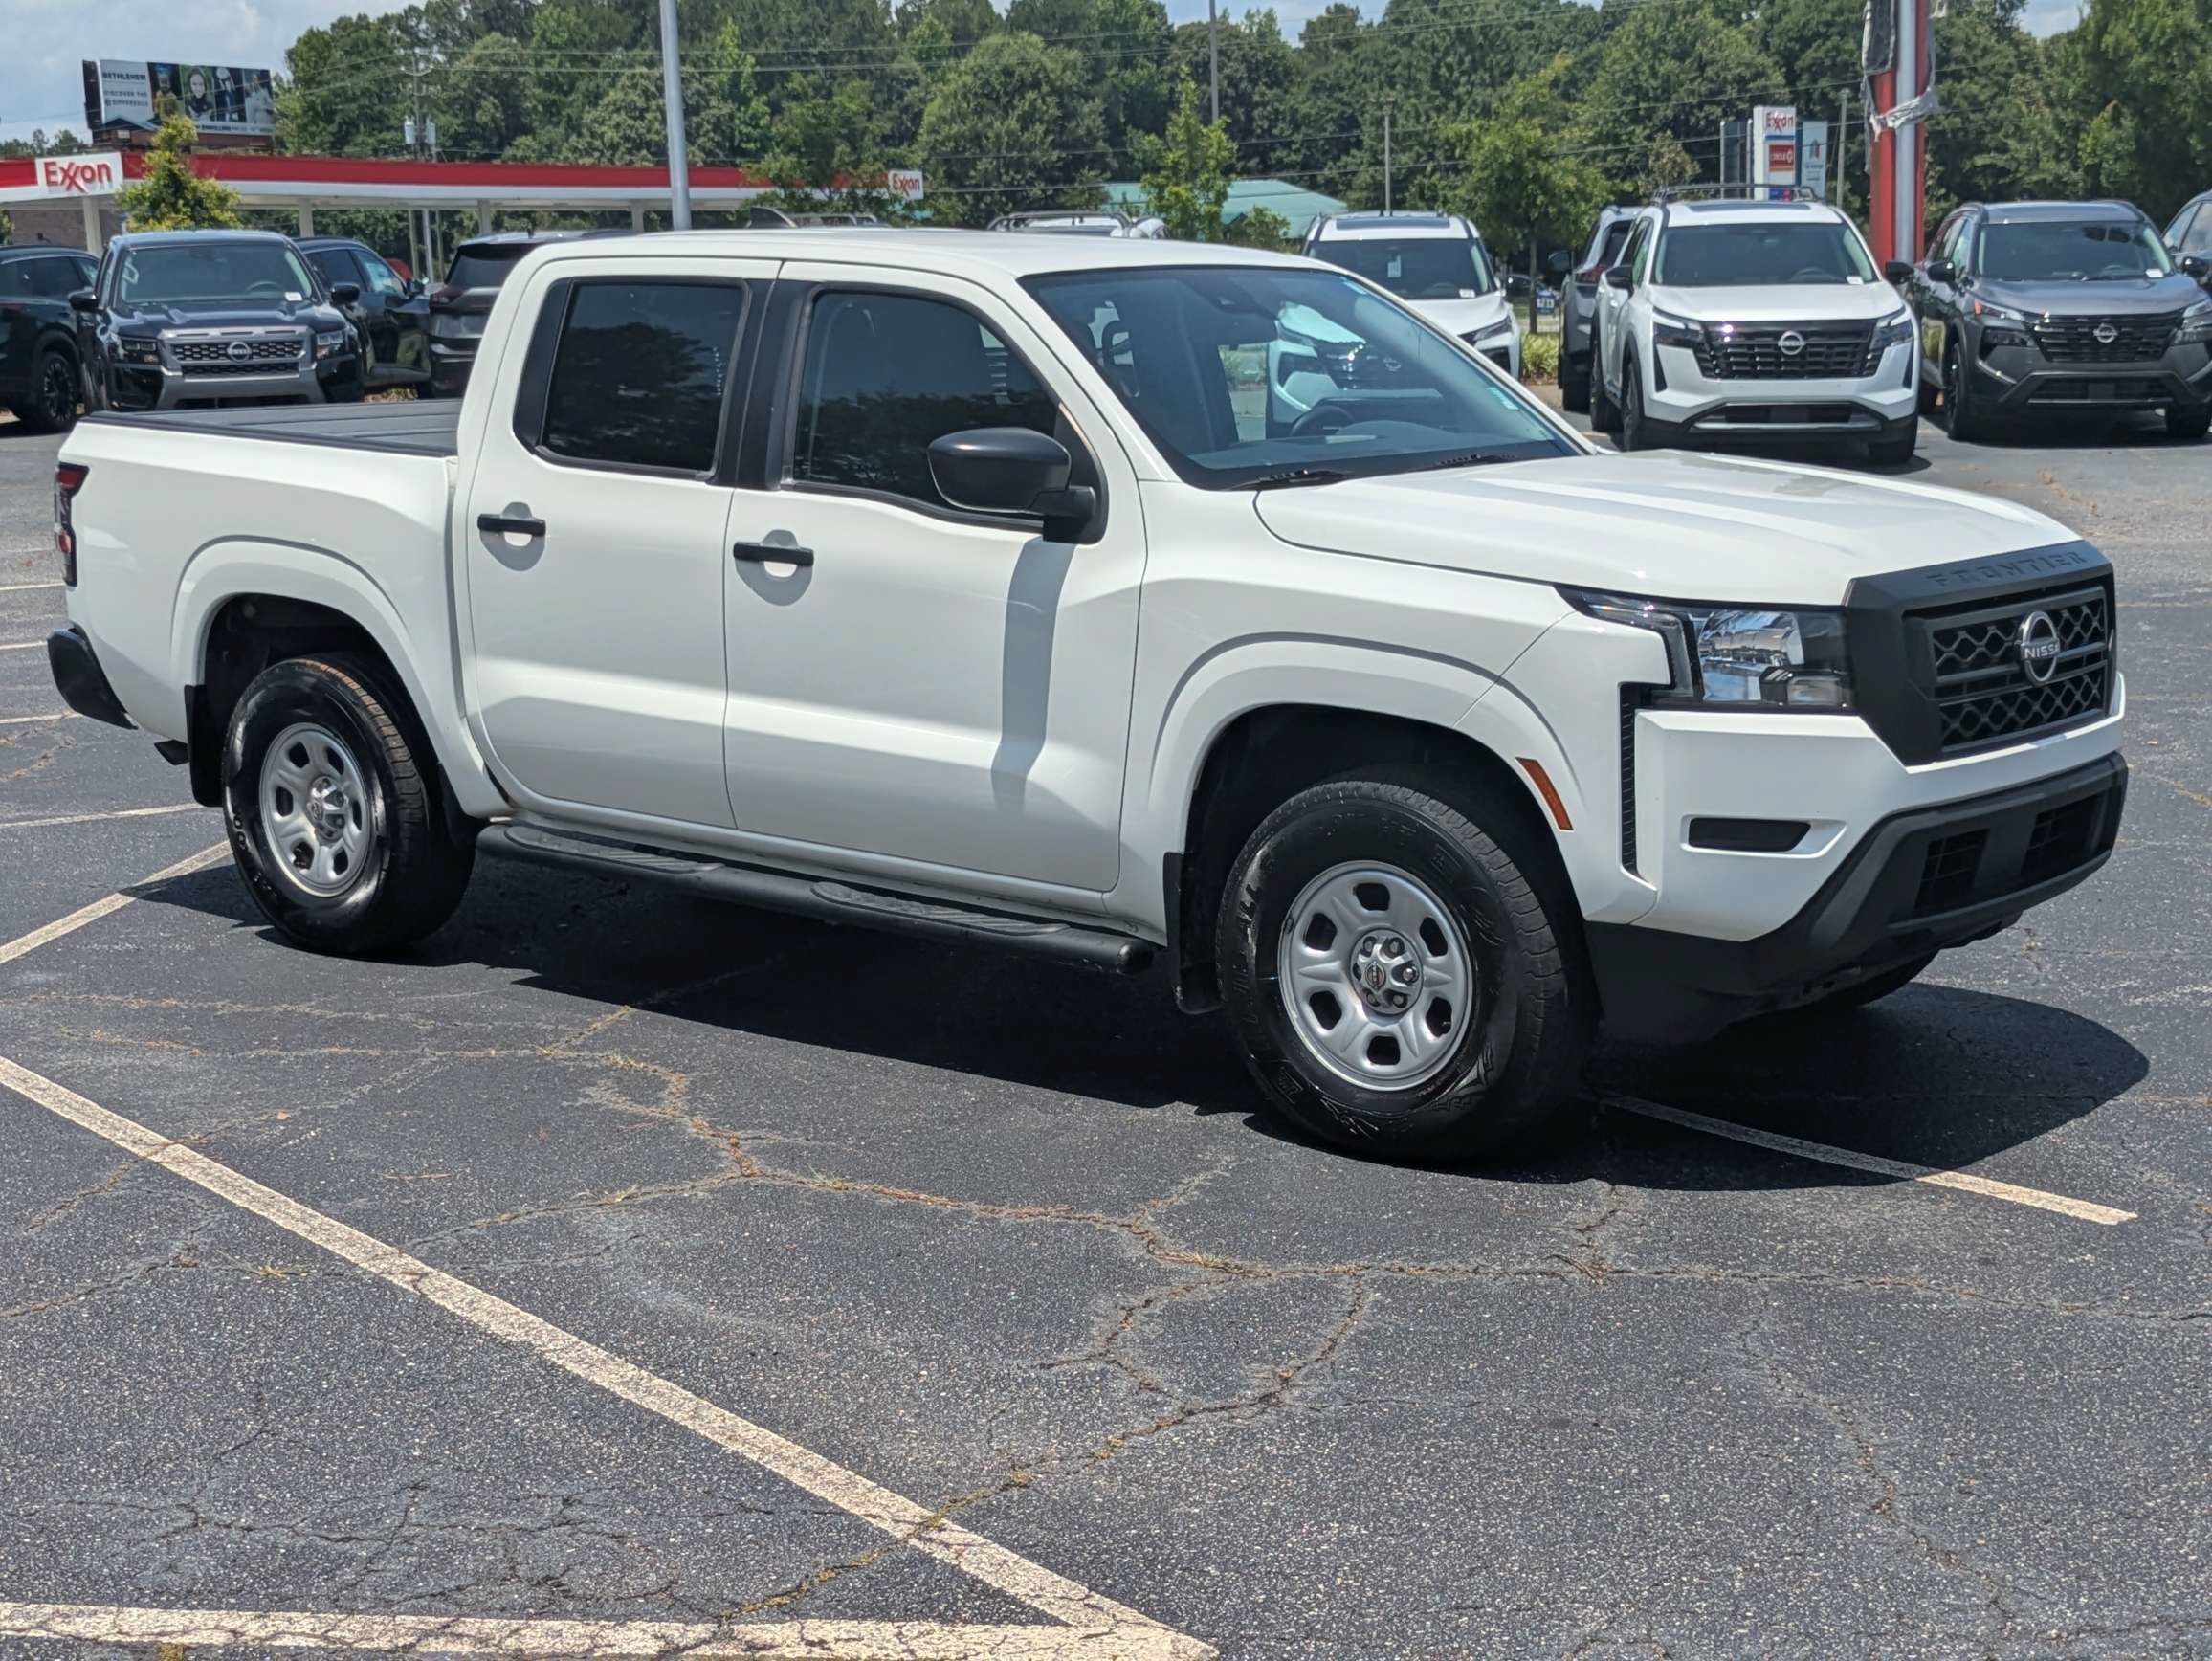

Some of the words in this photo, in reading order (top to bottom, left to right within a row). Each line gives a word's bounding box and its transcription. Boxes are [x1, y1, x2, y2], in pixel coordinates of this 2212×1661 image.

[1765, 112, 1793, 133] Exxon
[44, 161, 113, 194] Exxon
[893, 172, 920, 197] Exxon
[1927, 551, 2088, 587] FRONTIER
